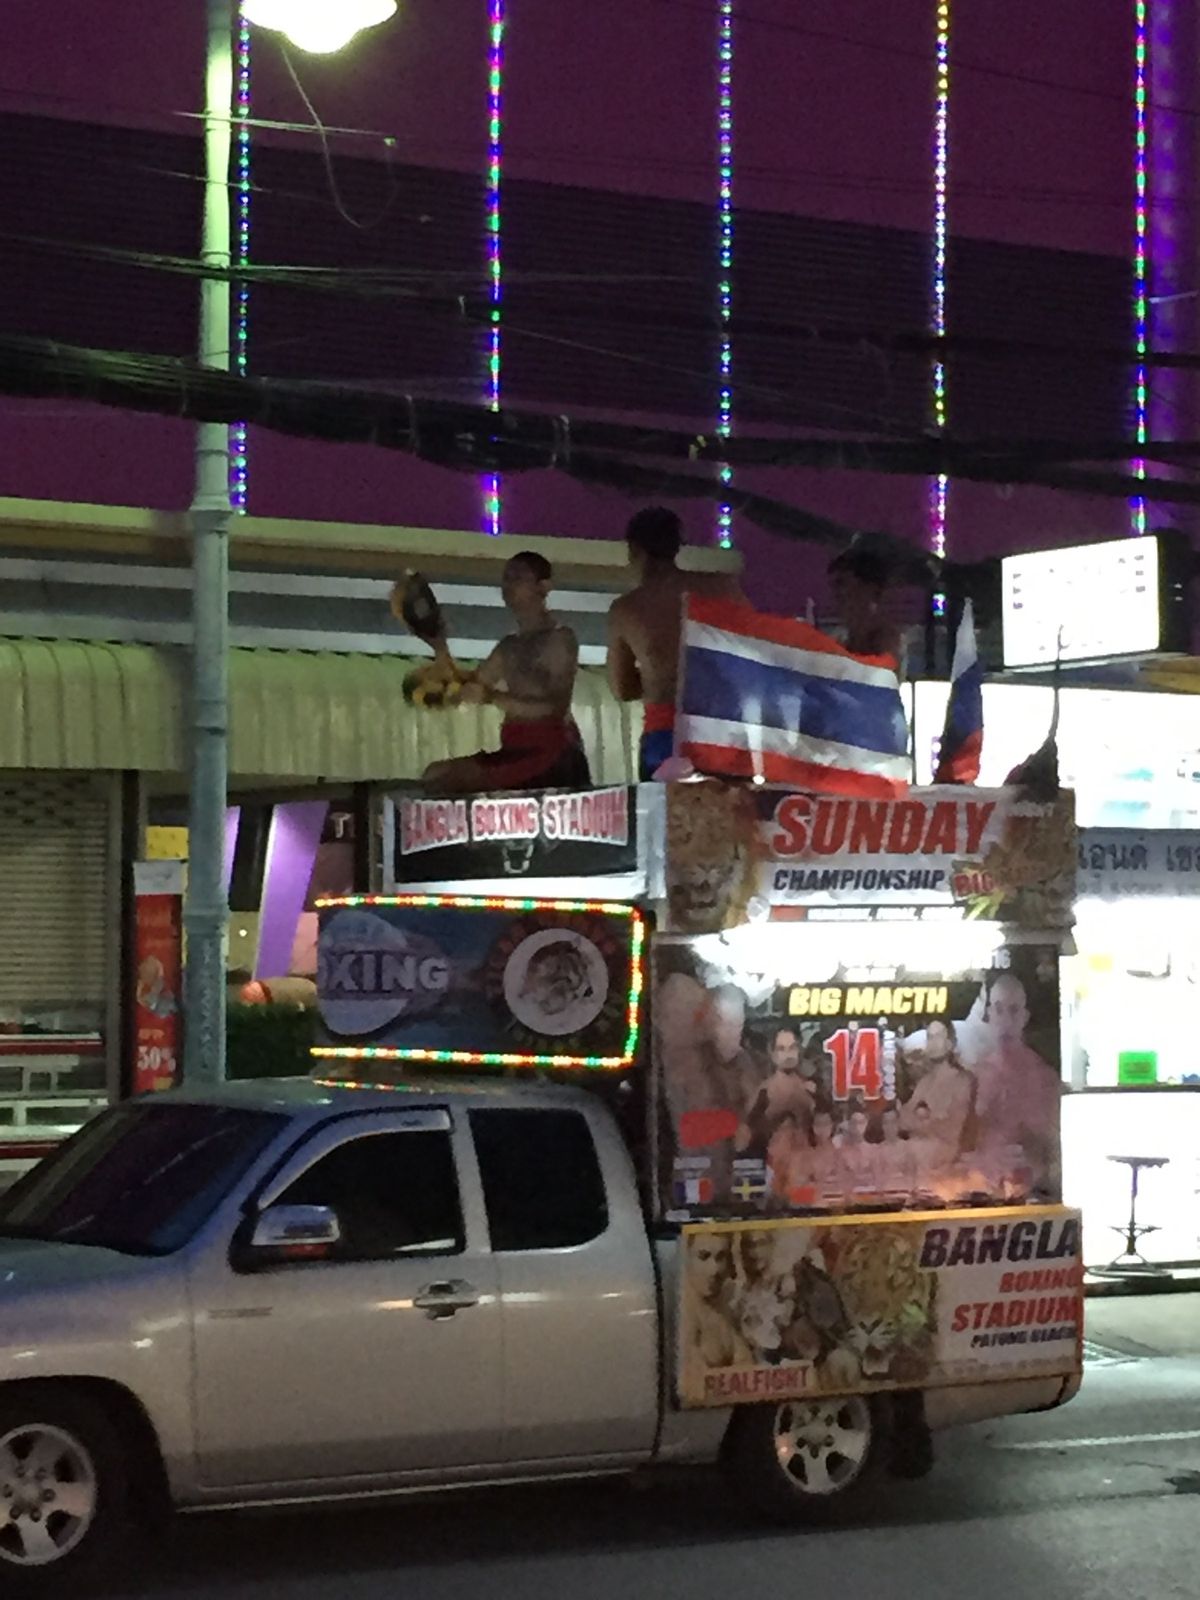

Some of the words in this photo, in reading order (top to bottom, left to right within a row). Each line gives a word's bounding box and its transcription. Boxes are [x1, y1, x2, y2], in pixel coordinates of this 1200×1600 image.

[471, 799, 540, 841] BOXING
[541, 787, 629, 846] STADIUM
[771, 795, 997, 855] SUNDAY
[772, 868, 946, 891] CHAMPIONSHIP
[788, 987, 841, 1016] BIG
[845, 986, 949, 1016] MACTH
[823, 1027, 882, 1101] 14
[919, 1218, 1079, 1269] BANGLA
[951, 1296, 1079, 1333] STADIUM
